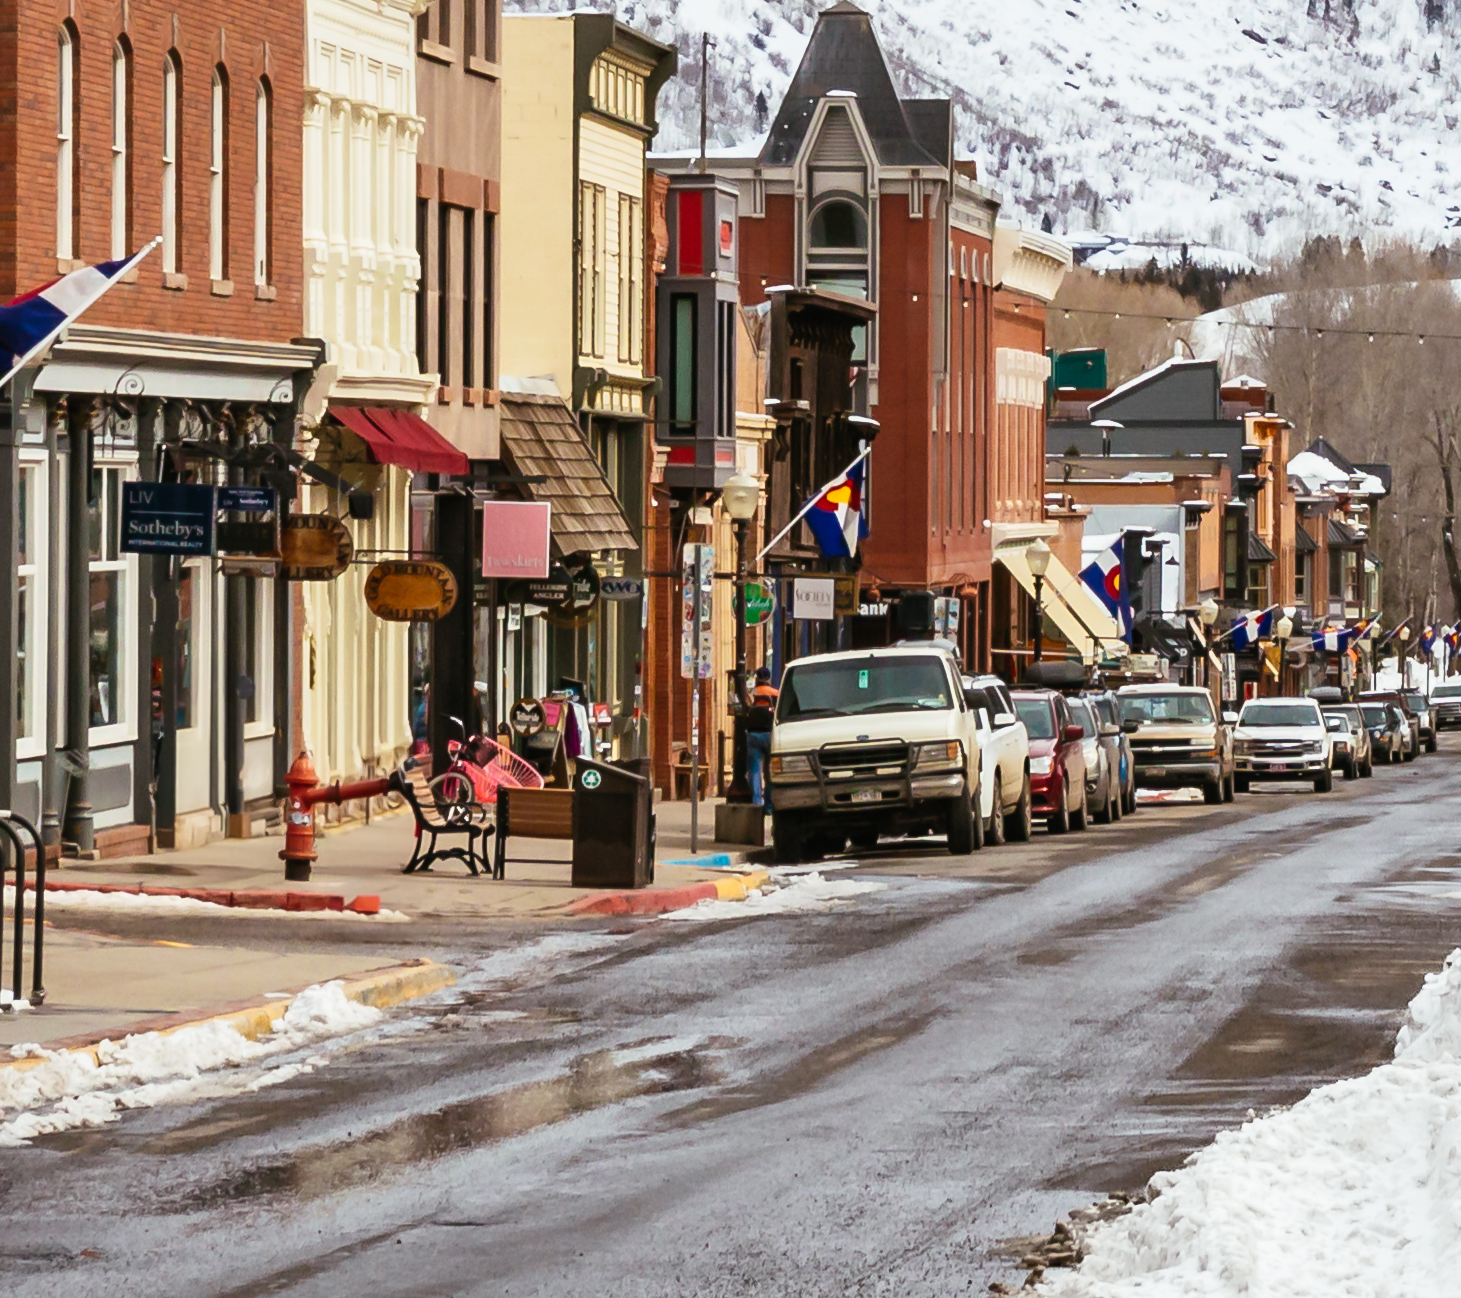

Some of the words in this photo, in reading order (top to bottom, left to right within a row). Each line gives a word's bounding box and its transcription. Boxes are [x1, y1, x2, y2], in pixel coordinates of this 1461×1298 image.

[129, 490, 154, 504] LIV
[128, 519, 204, 539] Sotheby's
[795, 588, 832, 602] SOCIETY
[857, 602, 889, 616] ank
